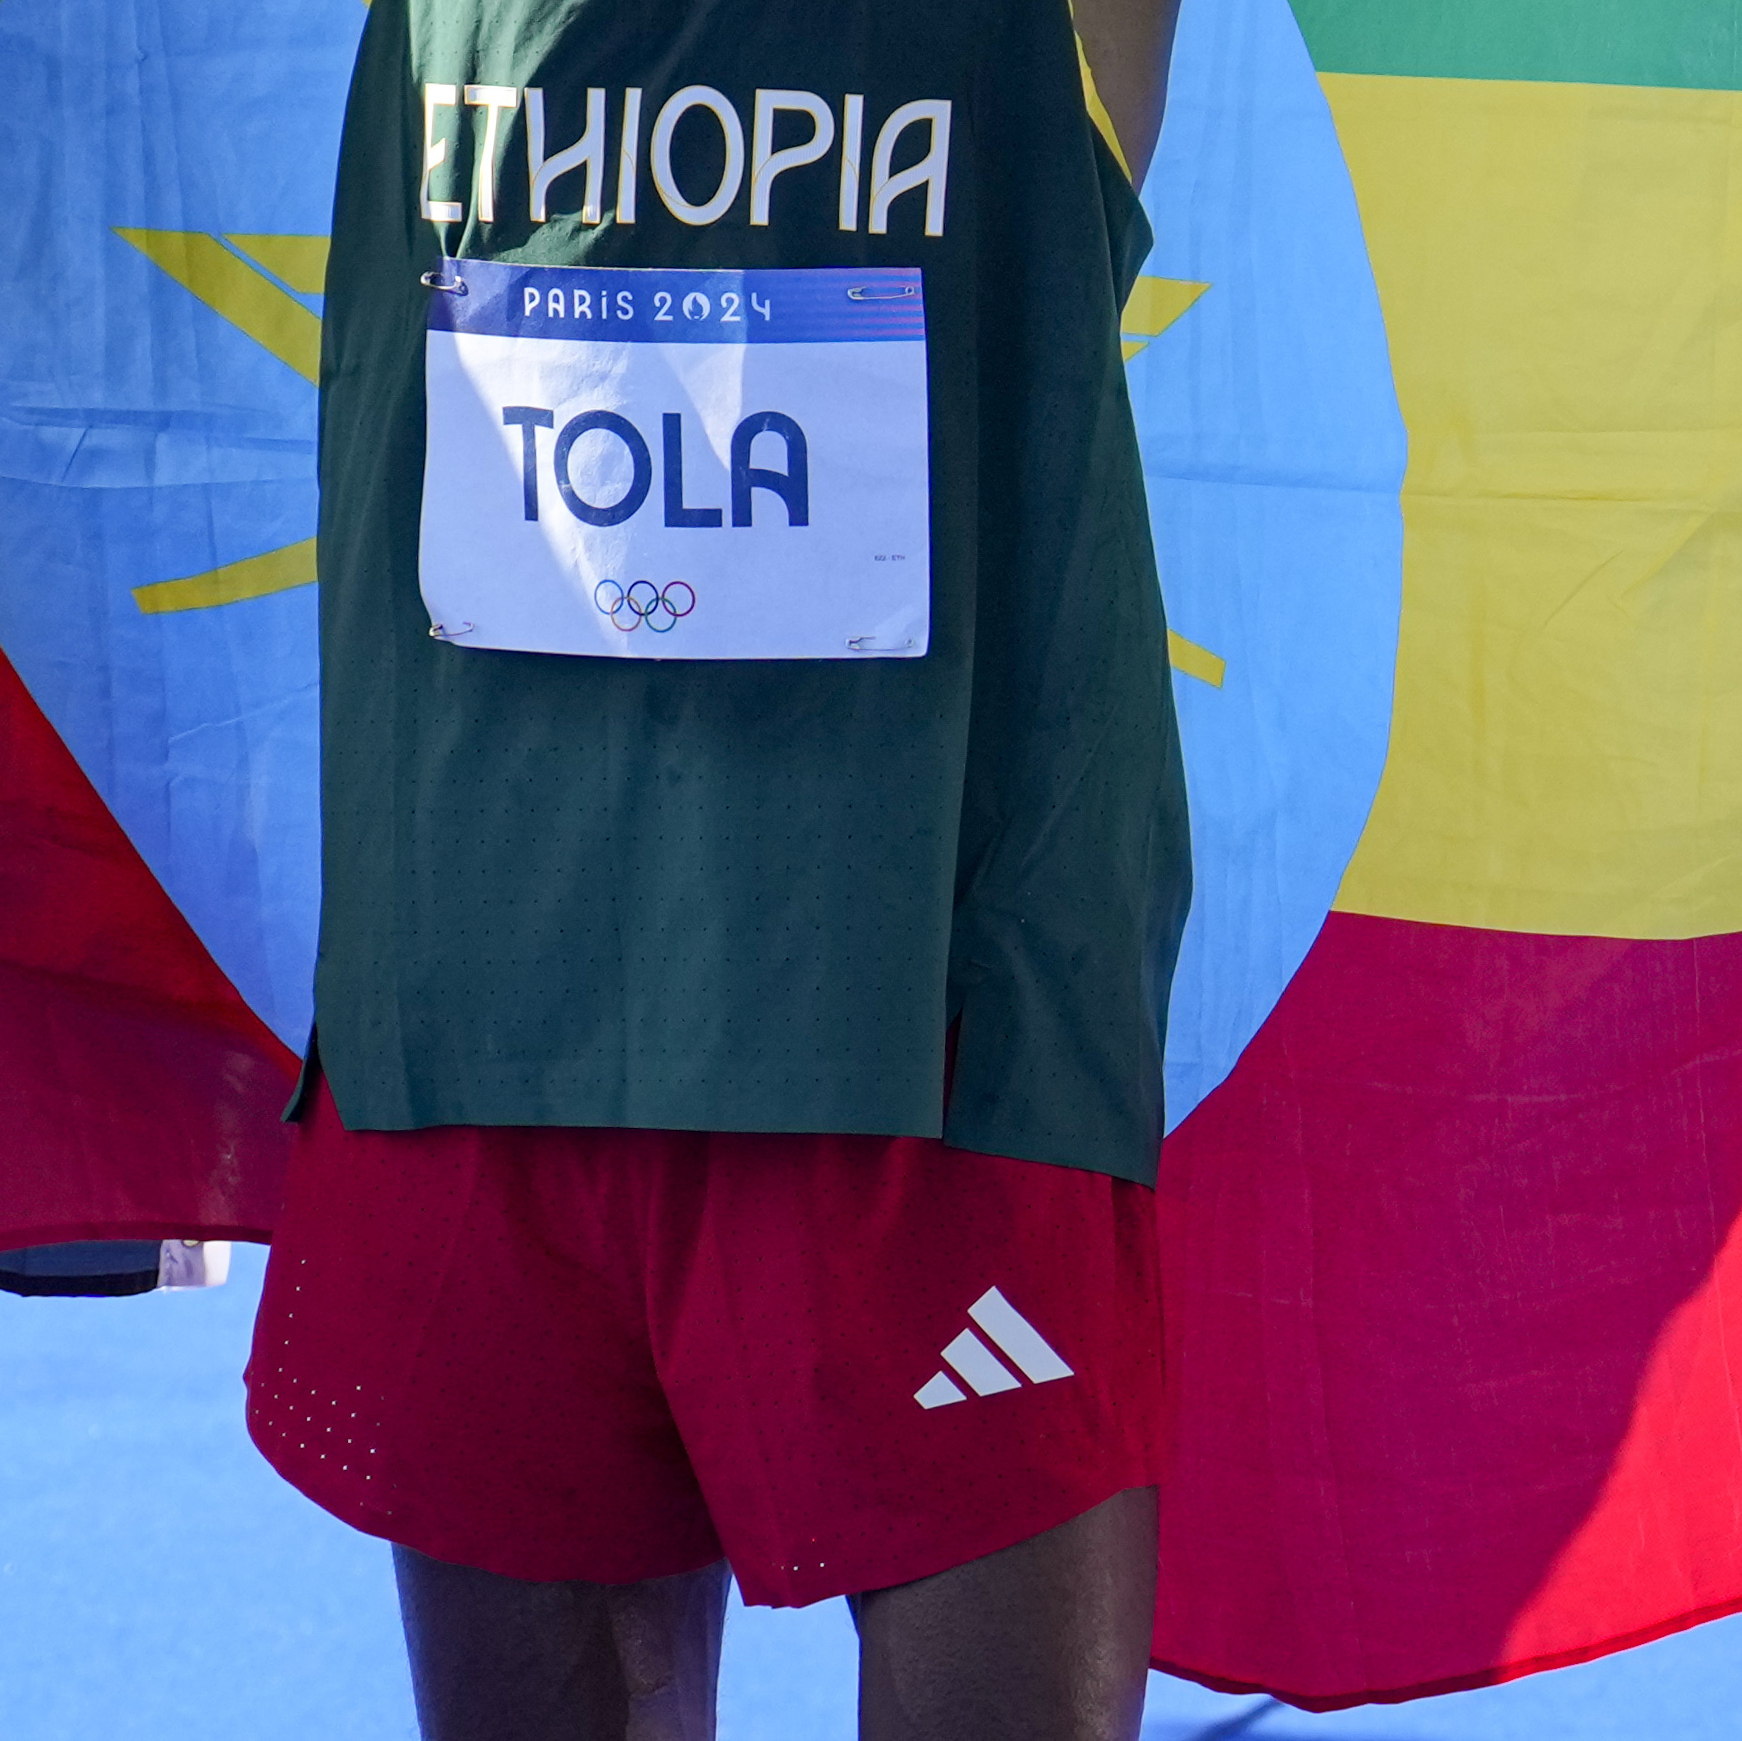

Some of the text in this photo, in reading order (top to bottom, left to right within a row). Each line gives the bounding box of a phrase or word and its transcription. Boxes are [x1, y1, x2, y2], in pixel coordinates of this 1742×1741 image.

[420, 83, 953, 237] ETHIOPIA
[653, 291, 771, 322] 2024
[502, 405, 810, 528] TOLA
